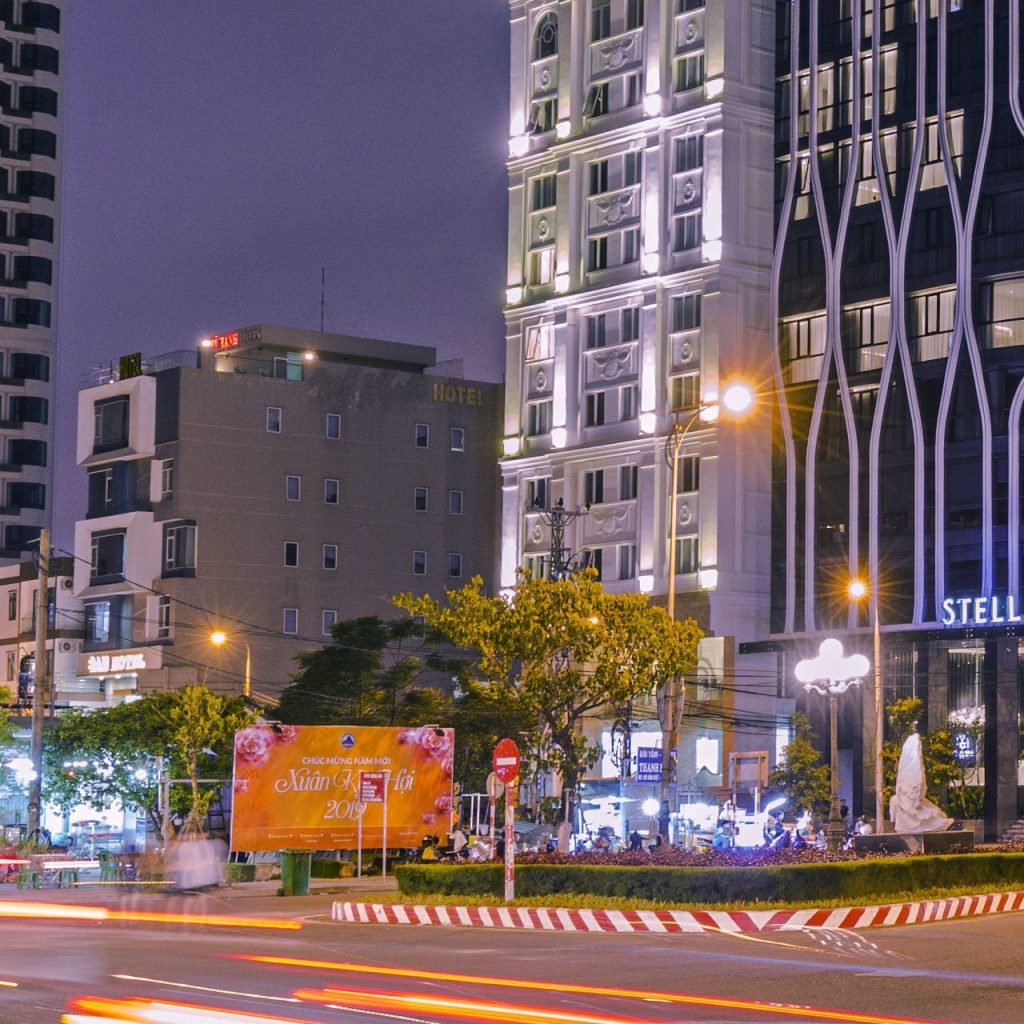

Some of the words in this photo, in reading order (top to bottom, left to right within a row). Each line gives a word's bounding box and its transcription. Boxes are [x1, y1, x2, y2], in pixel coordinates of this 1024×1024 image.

[302, 755, 325, 765] CHÚC
[354, 755, 374, 765] NĂM
[374, 754, 392, 765] MỚI
[274, 769, 329, 793] Xuân
[323, 799, 367, 820] 2019
